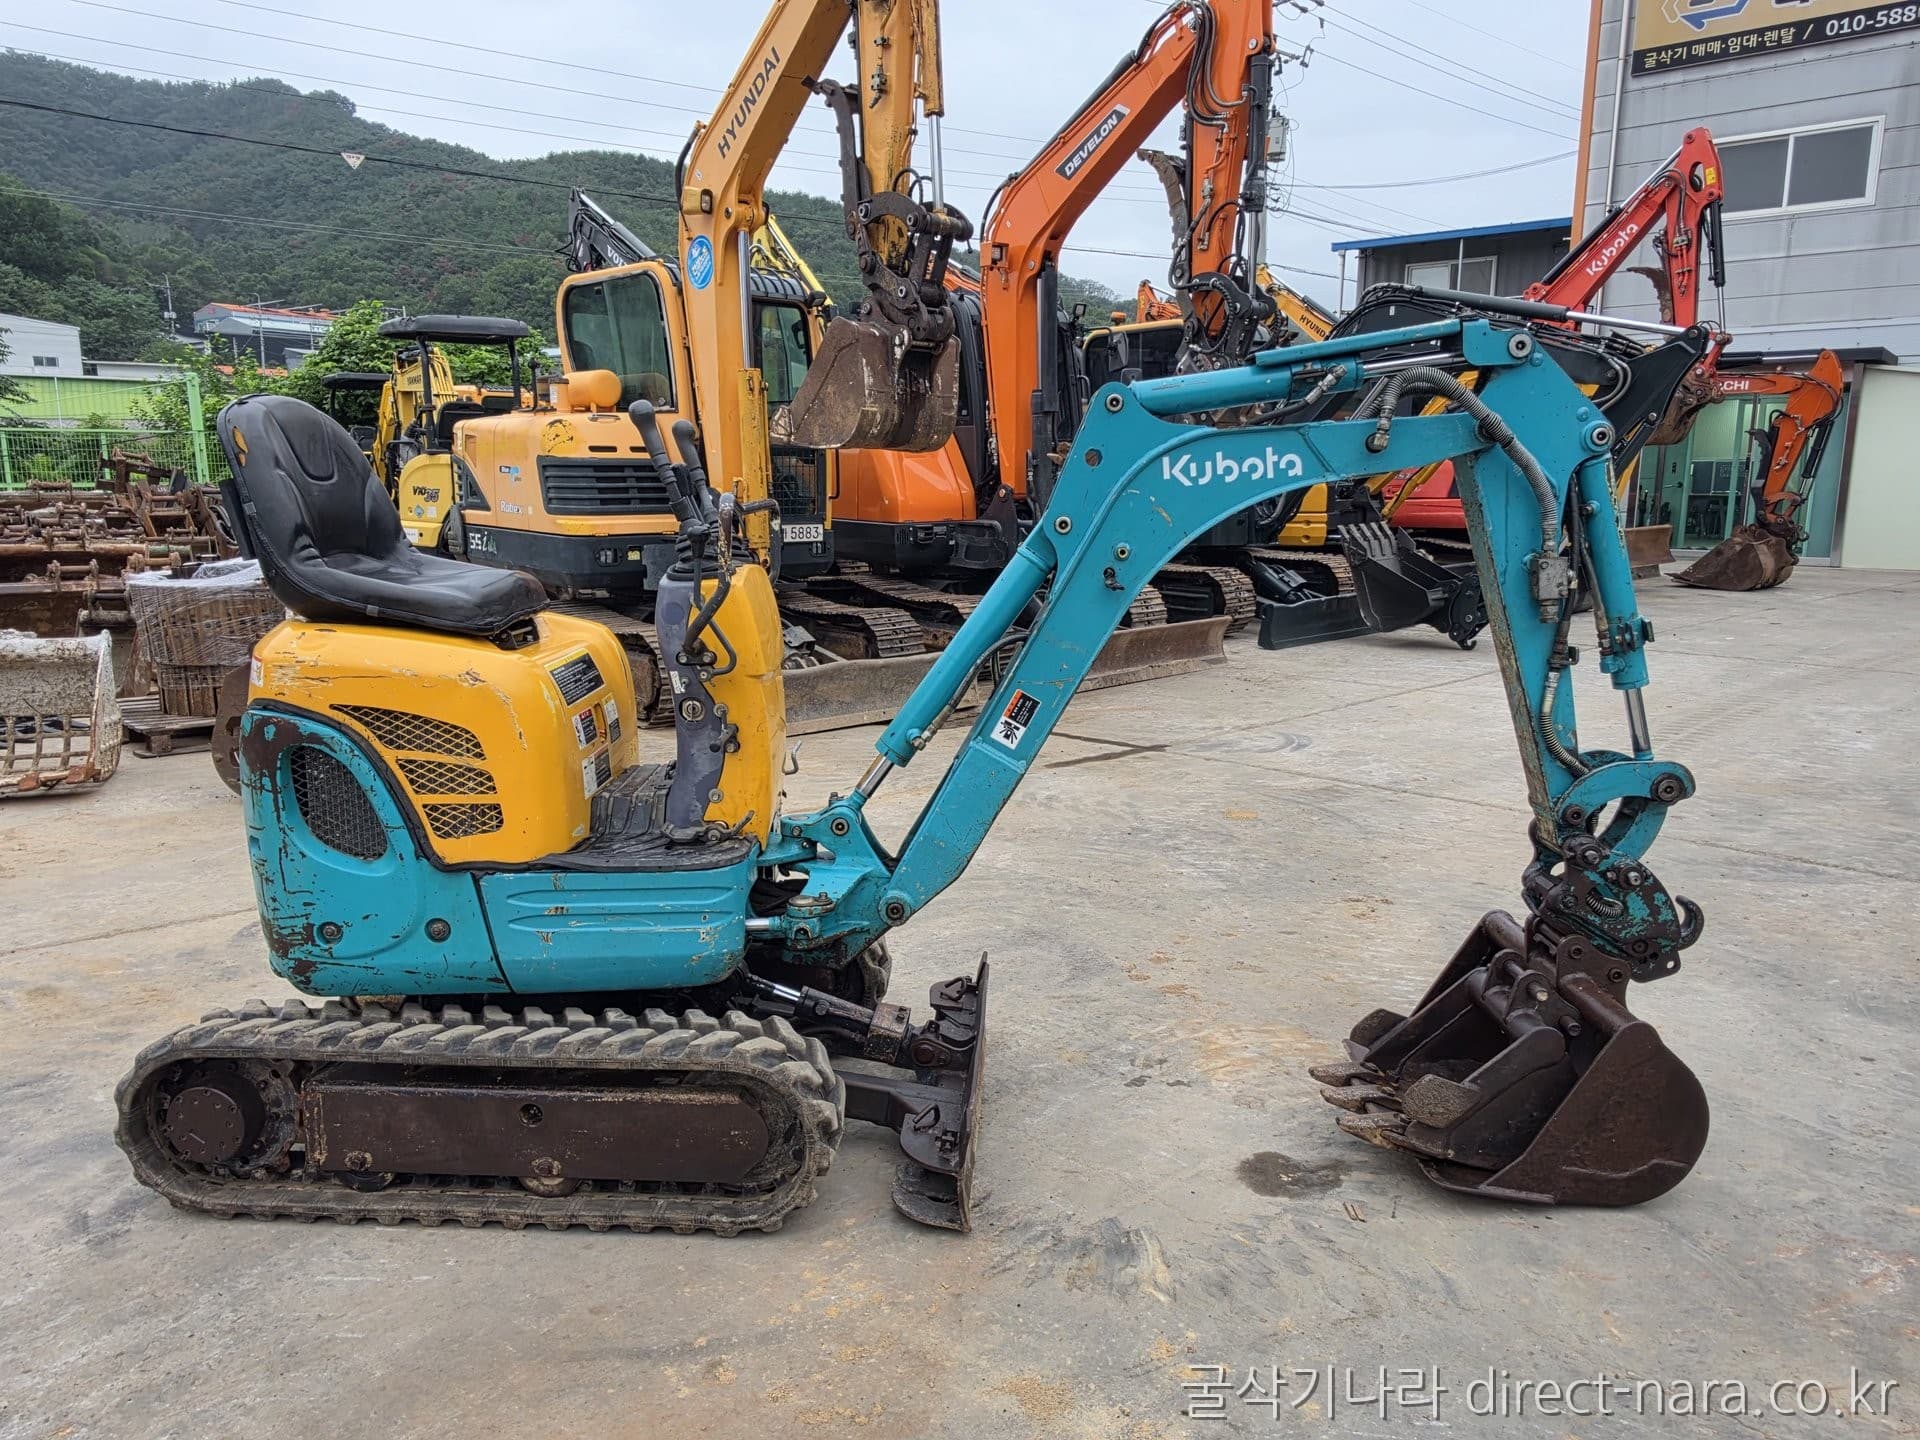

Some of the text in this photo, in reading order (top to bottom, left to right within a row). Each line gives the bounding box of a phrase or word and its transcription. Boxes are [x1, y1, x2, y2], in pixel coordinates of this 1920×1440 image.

[1644, 46, 1688, 69] 굴삭기
[1825, 5, 1920, 36] 010-588
[717, 46, 781, 159] HYUNDAI
[1064, 113, 1119, 177] DEVELON
[1586, 223, 1639, 276] Kubota
[1299, 314, 1326, 338] HYUND
[1162, 447, 1303, 487] Kubota
[790, 526, 820, 540] 5883
